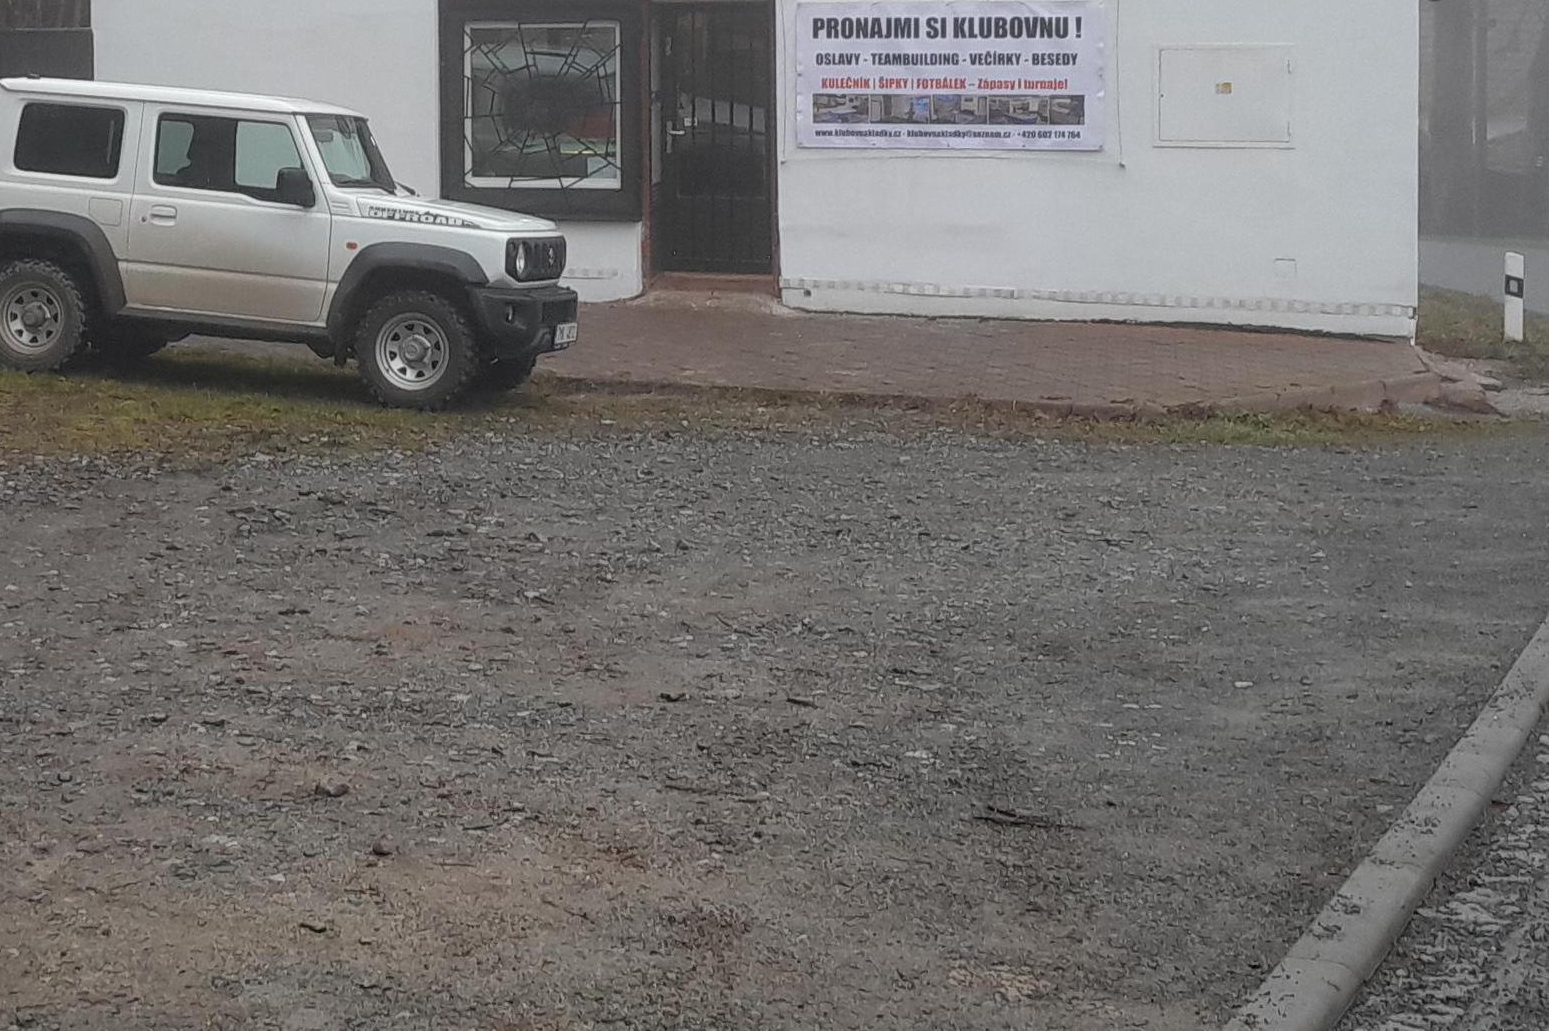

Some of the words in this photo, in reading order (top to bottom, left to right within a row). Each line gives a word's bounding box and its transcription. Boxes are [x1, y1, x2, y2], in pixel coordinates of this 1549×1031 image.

[812, 17, 920, 39] PRONAJMI
[925, 17, 947, 39] SI
[953, 16, 1069, 39] KLUBOVNU
[815, 53, 861, 66] OSLAVY
[871, 53, 959, 66] TEAMBUILDING
[969, 50, 1021, 66] VEČÍRKY
[1032, 53, 1078, 66] BESEDY
[878, 76, 908, 89] ŠIPKY
